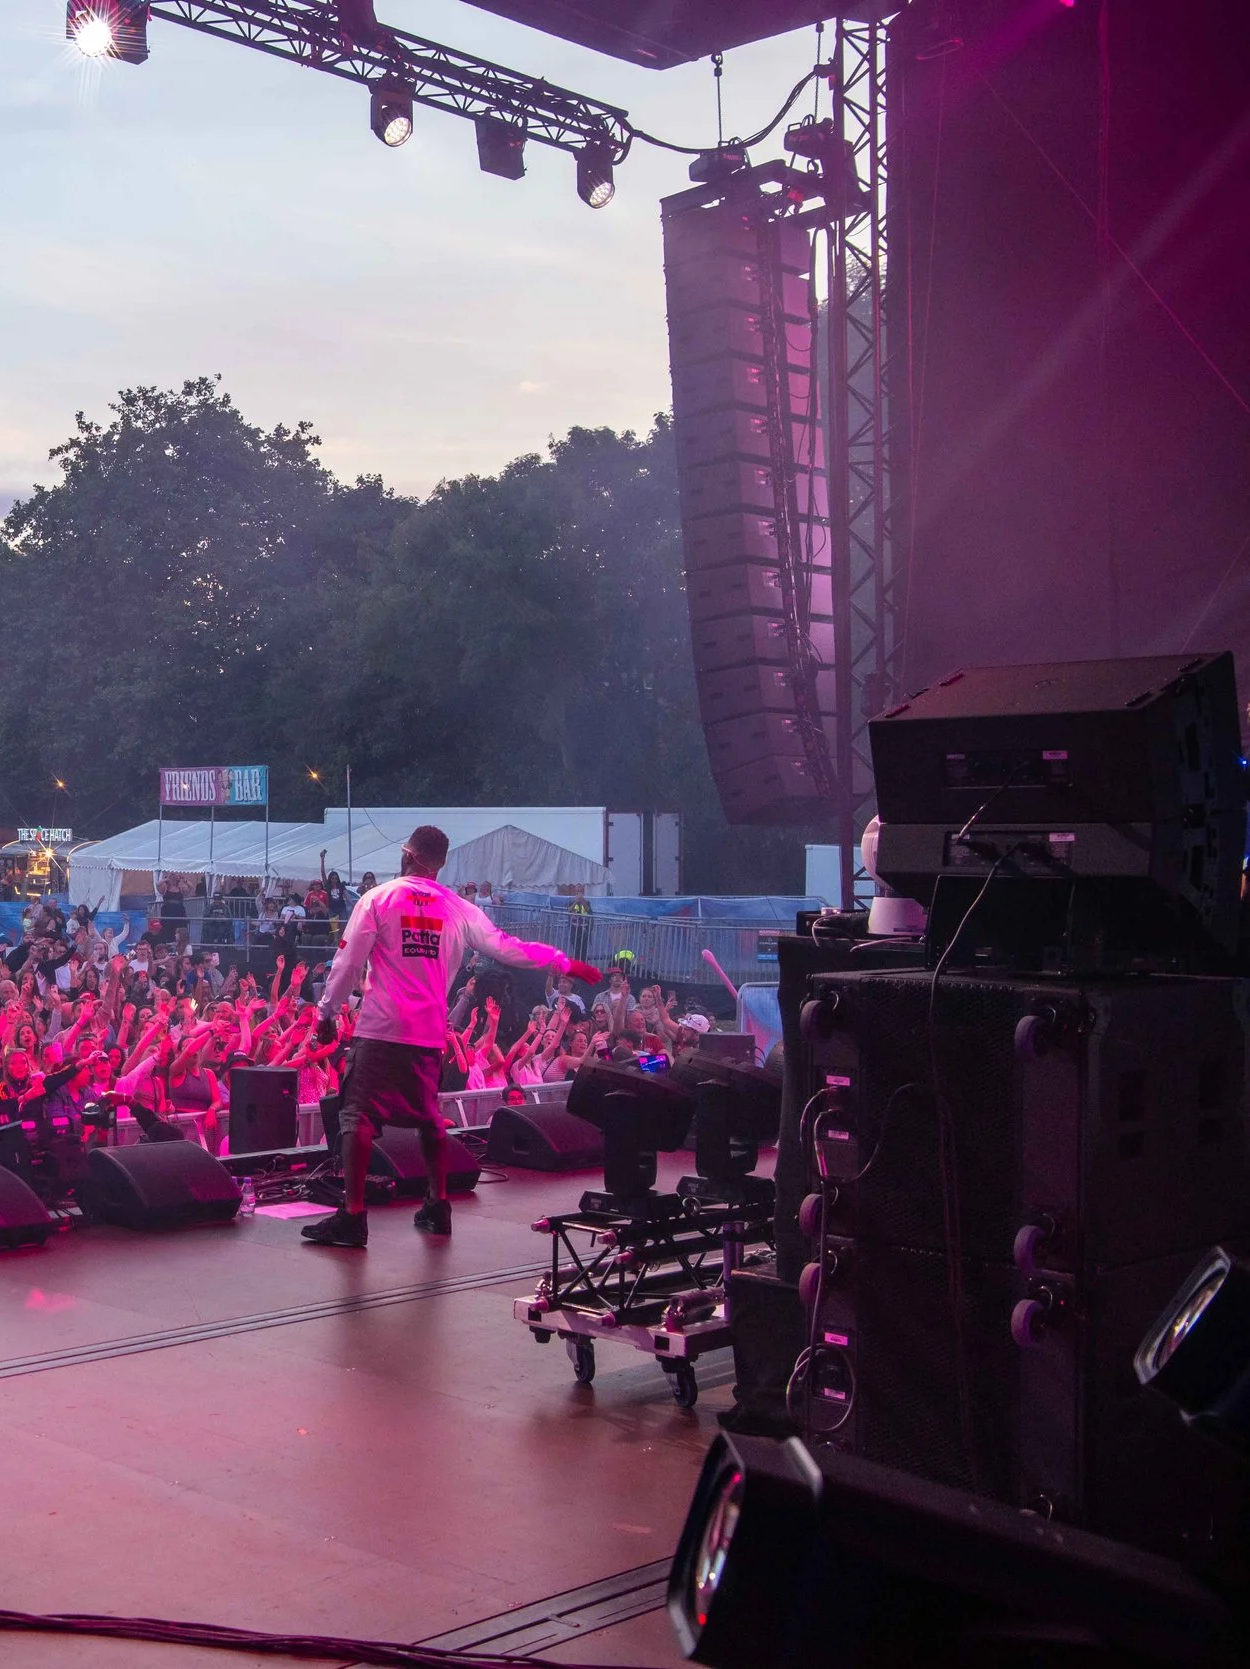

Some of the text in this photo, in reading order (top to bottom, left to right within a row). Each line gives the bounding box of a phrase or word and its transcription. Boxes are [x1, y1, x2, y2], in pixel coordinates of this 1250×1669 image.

[164, 768, 262, 801] FRIENDS BAR
[17, 828, 29, 841] THE
[50, 828, 71, 841] HATCH
[401, 929, 441, 946] Patta
